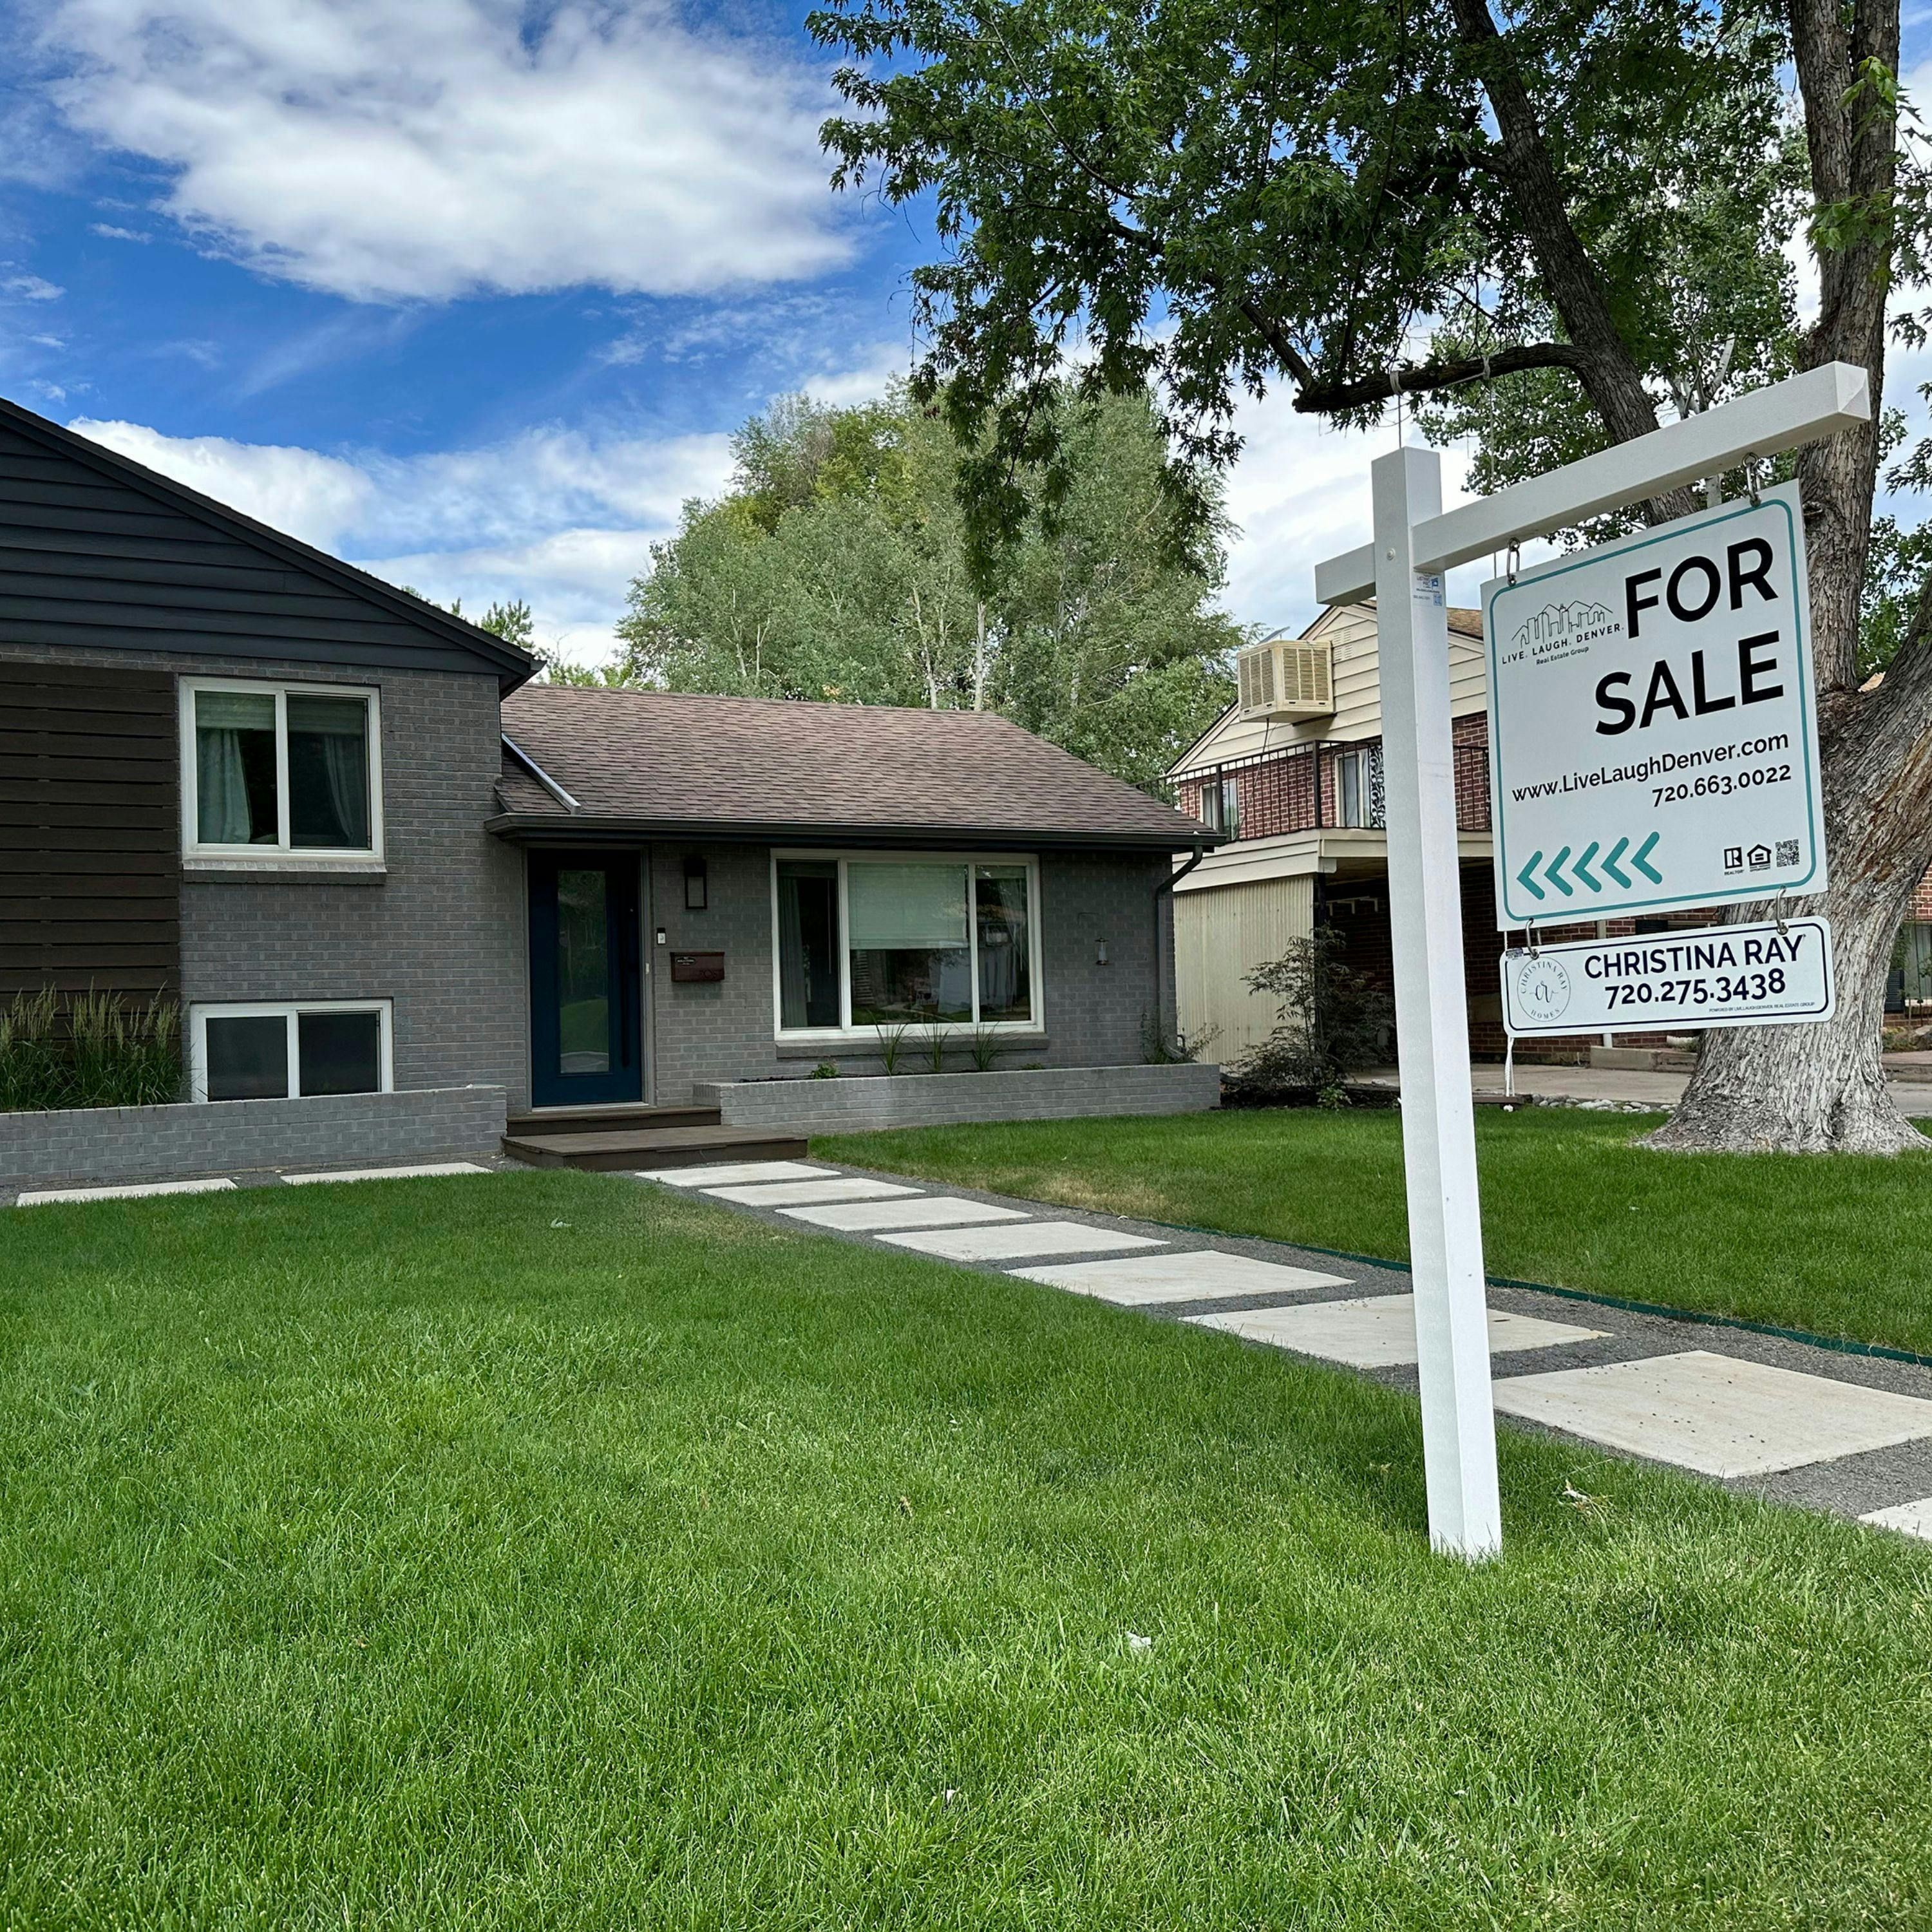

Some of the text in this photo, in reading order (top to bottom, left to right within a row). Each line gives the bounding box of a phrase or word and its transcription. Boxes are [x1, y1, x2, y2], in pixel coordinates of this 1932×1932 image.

[1625, 537, 1779, 639] FOR
[1502, 623, 1625, 665] LIVE. LAUGH. DENVER.
[1536, 646, 1589, 665] Real Estate Group
[1595, 630, 1784, 735] SALE
[1511, 733, 1789, 802] www.LiveLaughDenver.com
[1652, 764, 1792, 808] 720.663.0022
[1584, 934, 1804, 979] CHRISTINA RAY
[1605, 968, 1786, 1010] 720.275.3438
